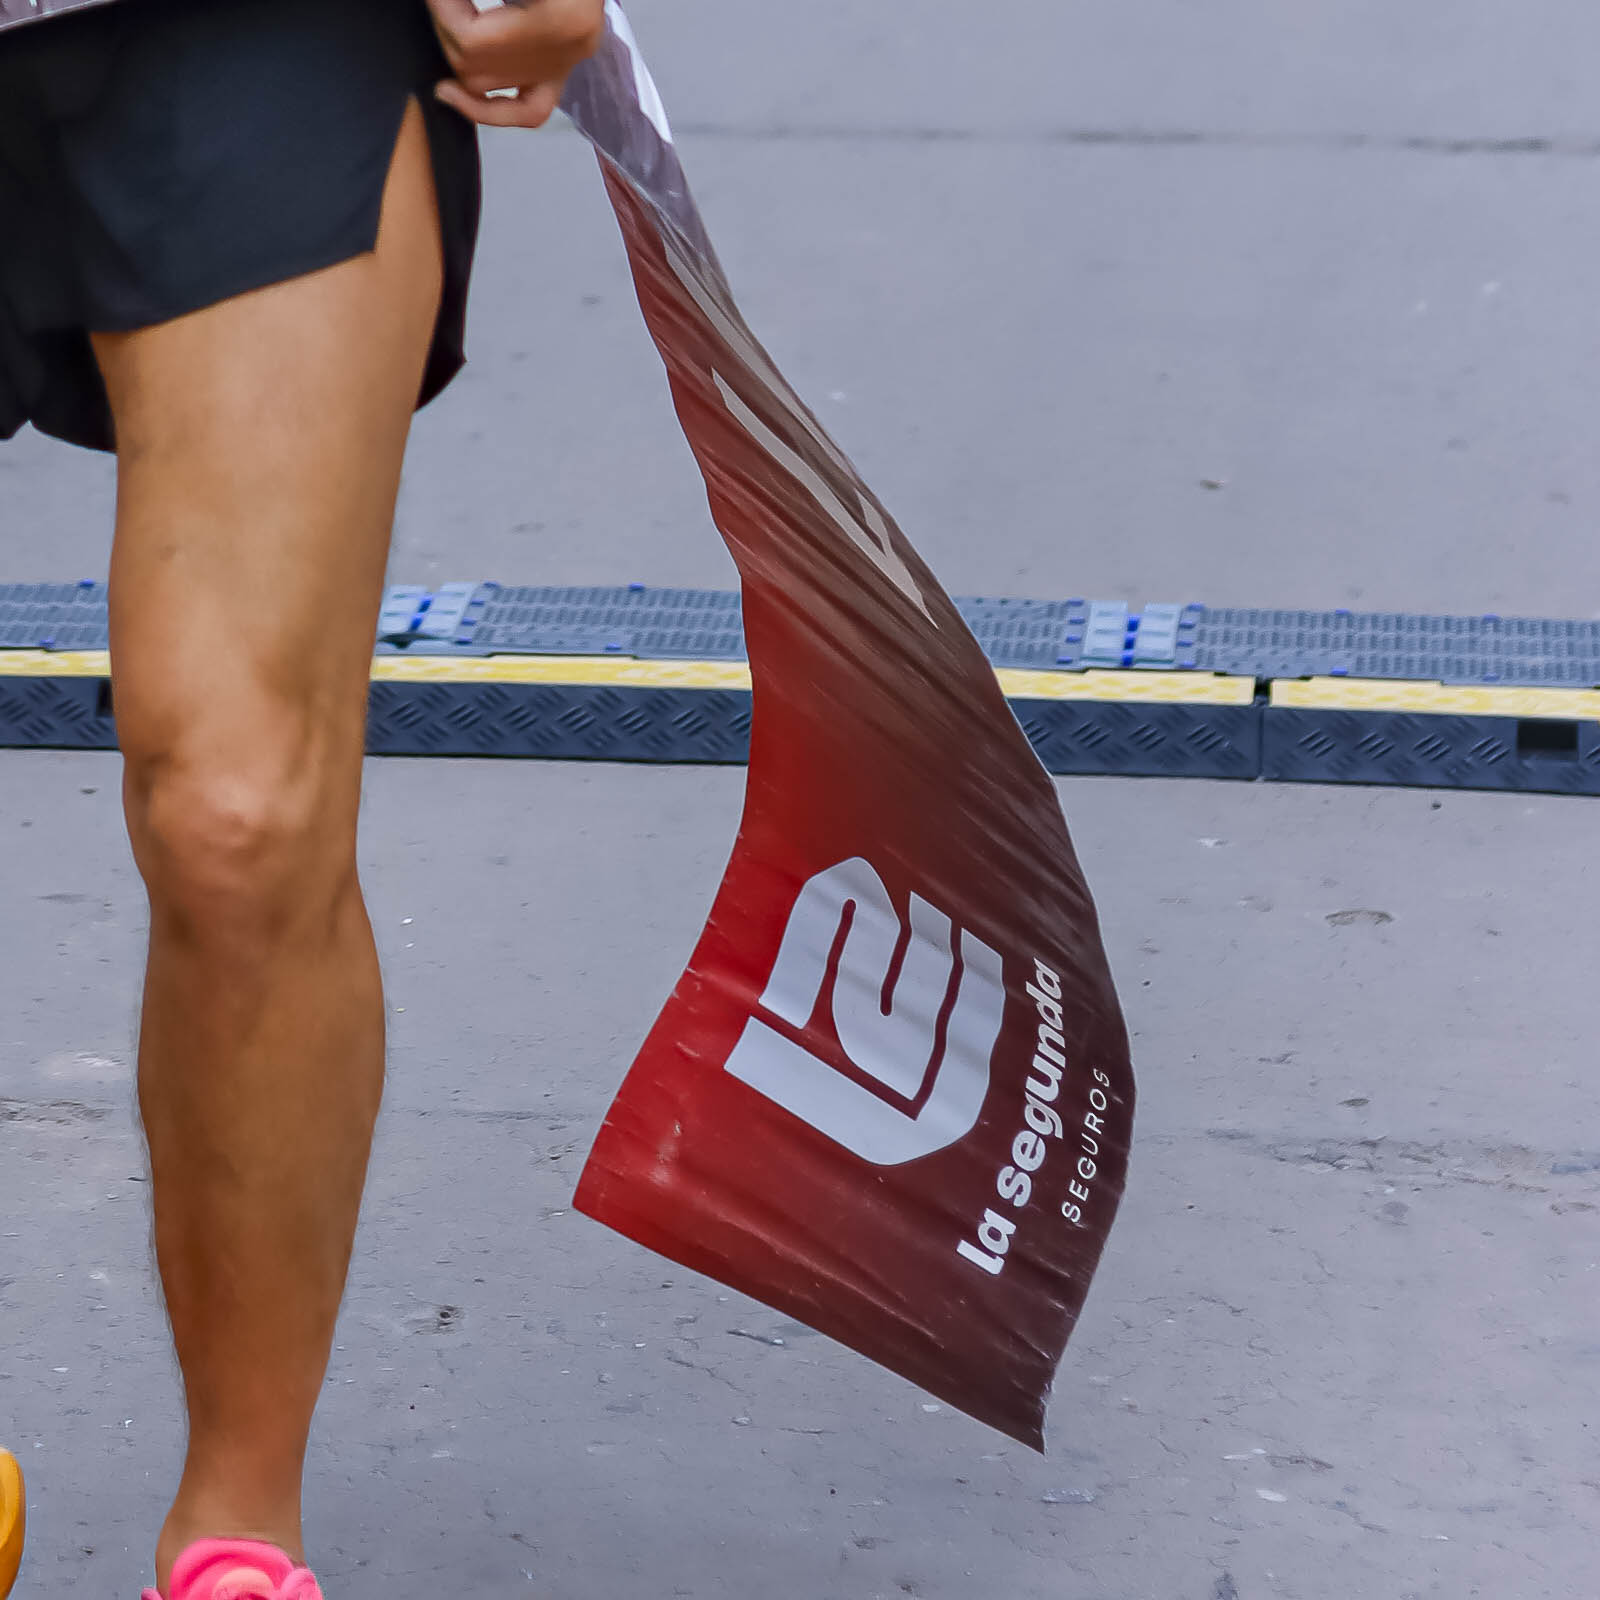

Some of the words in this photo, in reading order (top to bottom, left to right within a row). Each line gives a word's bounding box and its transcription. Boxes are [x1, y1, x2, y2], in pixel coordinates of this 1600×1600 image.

[956, 1208, 1018, 1275] la
[995, 957, 1065, 1208] segunda
[1061, 1068, 1112, 1224] SEGUROS
